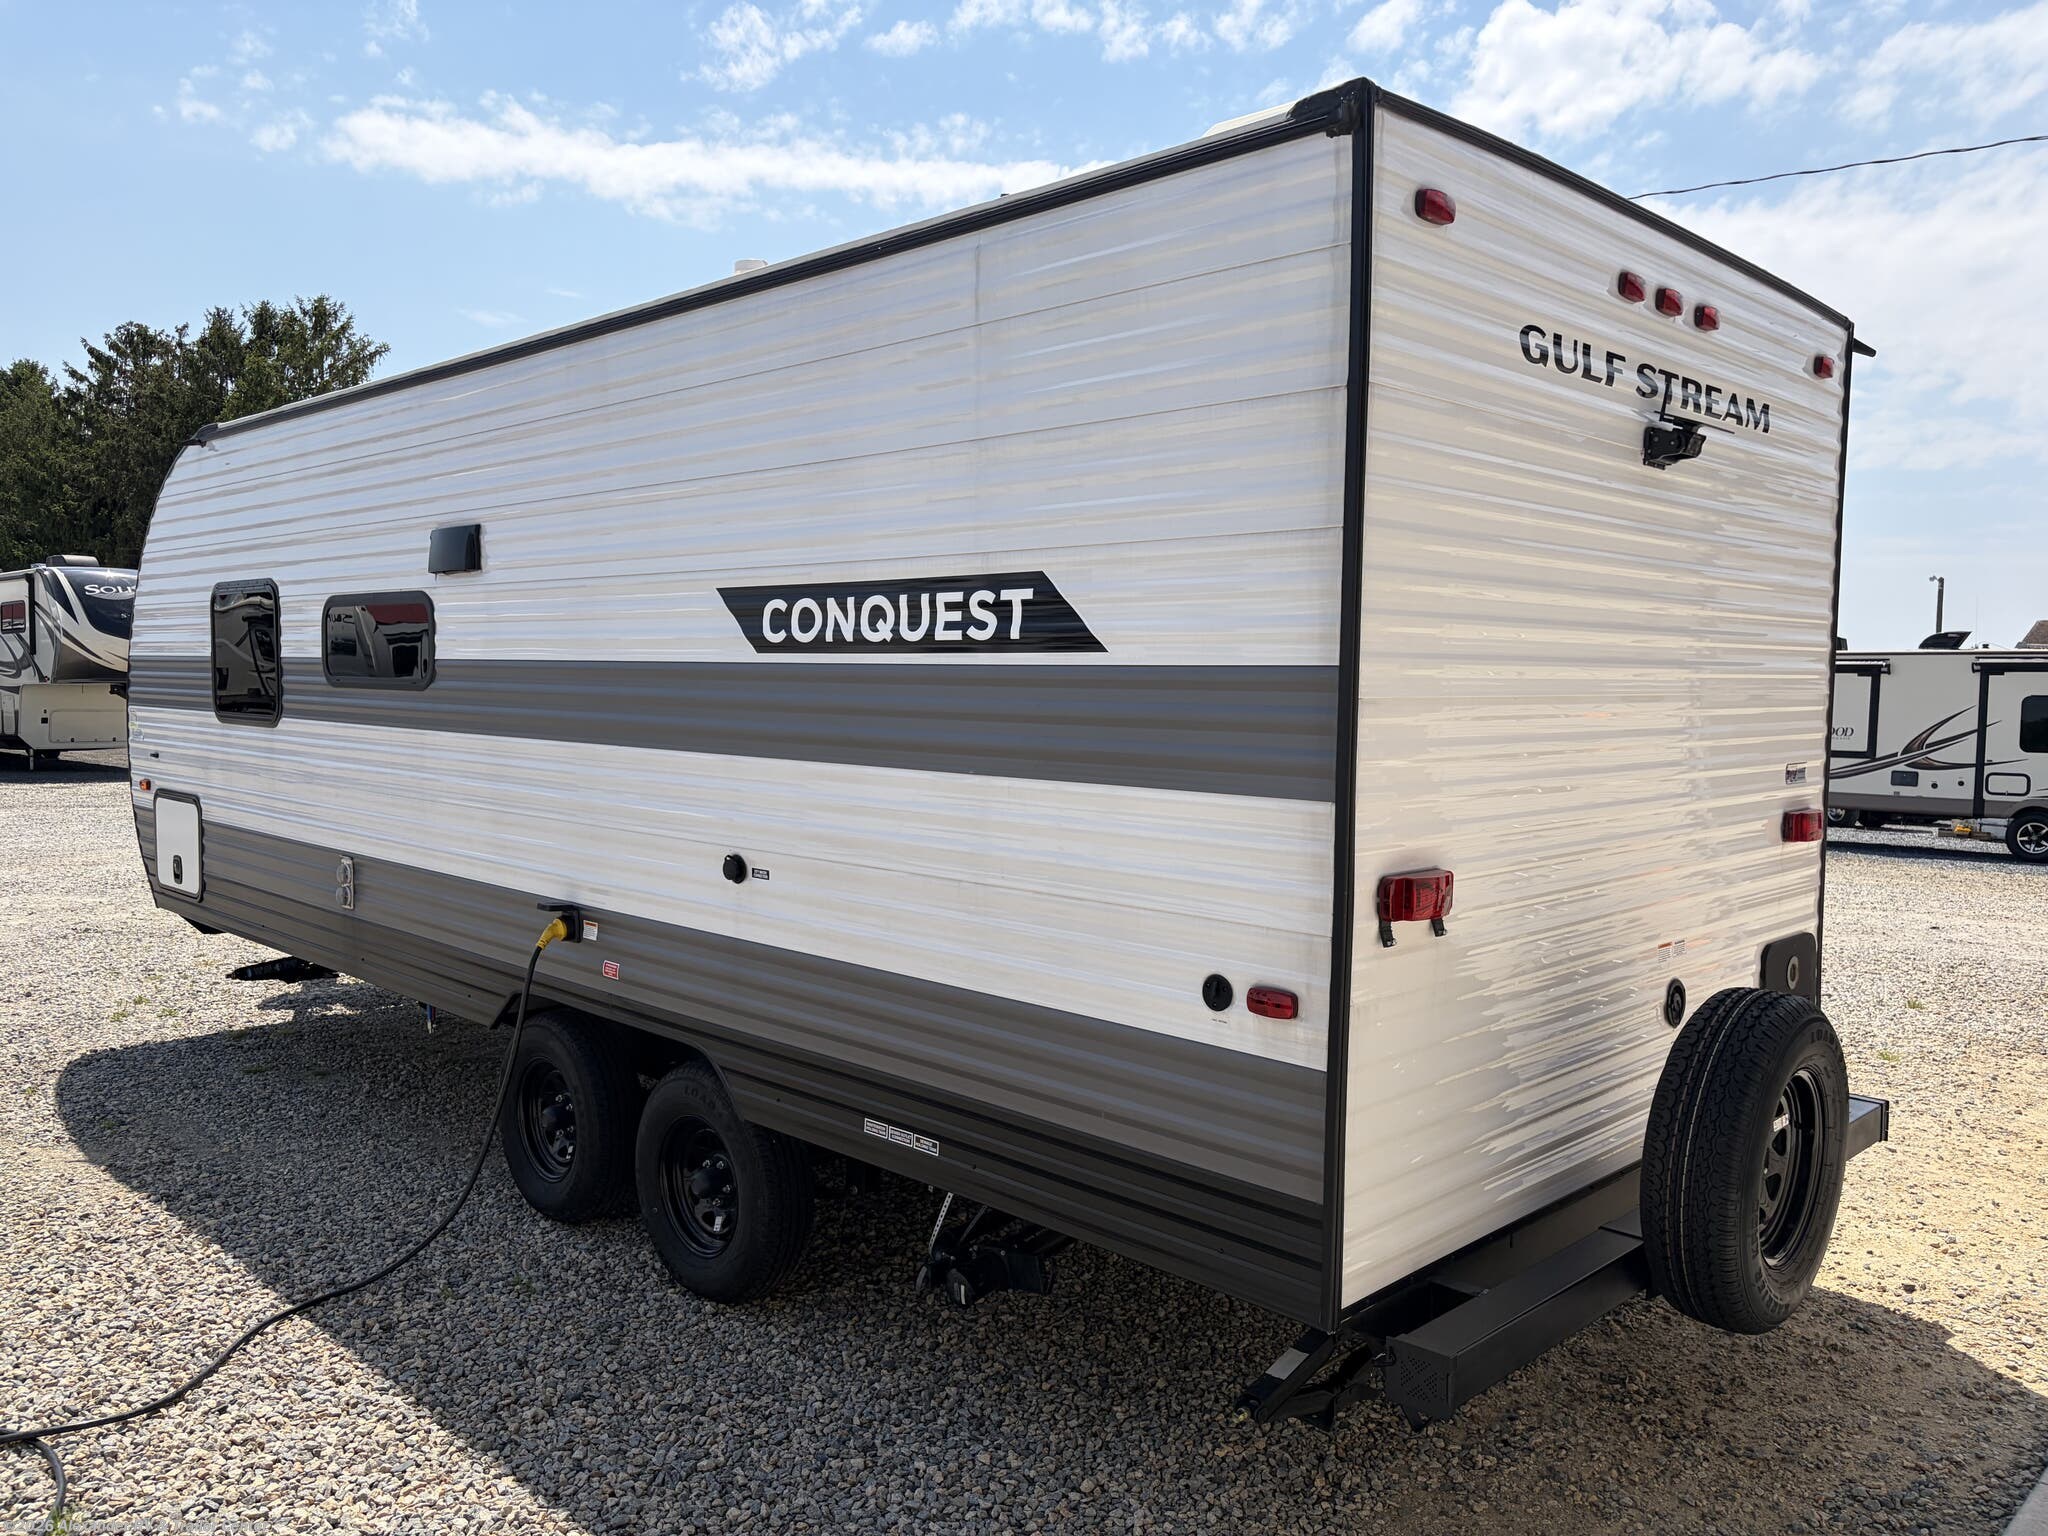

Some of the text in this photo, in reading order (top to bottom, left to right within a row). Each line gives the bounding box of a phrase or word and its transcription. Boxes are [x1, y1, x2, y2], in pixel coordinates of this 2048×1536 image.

[1519, 324, 1770, 433] GULF STREAM
[762, 588, 1034, 643] CONQUEST
